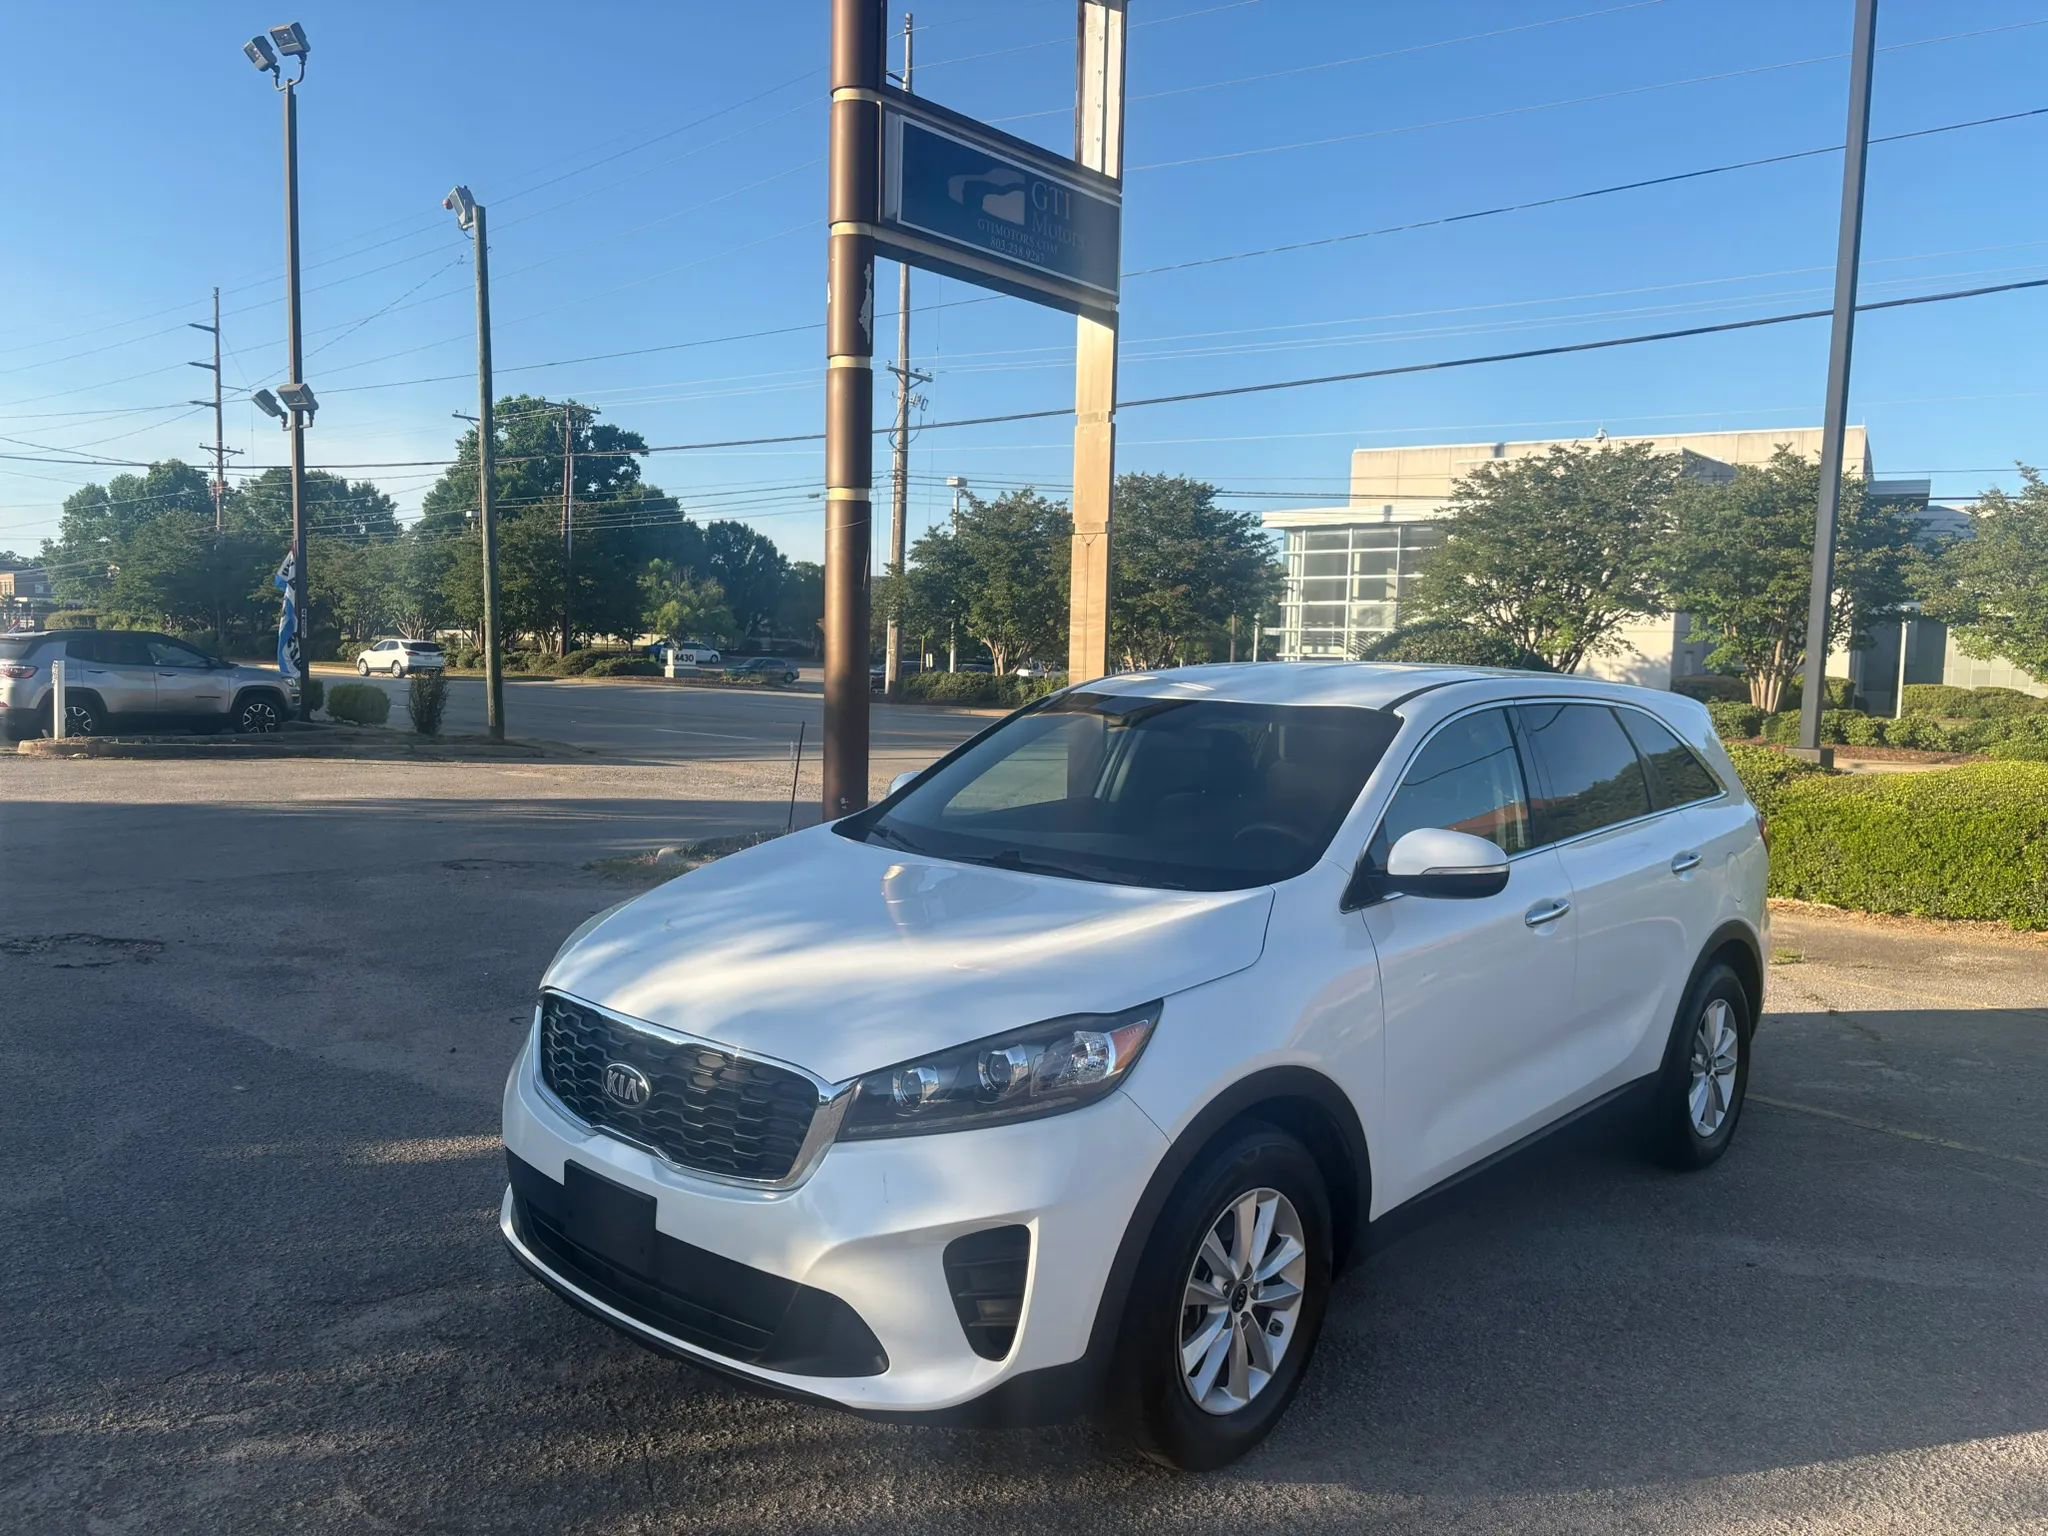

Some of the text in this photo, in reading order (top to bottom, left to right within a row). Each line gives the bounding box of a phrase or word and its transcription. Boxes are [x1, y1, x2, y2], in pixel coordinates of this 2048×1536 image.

[1032, 181, 1071, 220] GTI
[977, 218, 1058, 256] GTIMOTORS.COM
[1032, 210, 1086, 249] Motors
[675, 653, 694, 662] 4430
[607, 1069, 639, 1103] KIA
